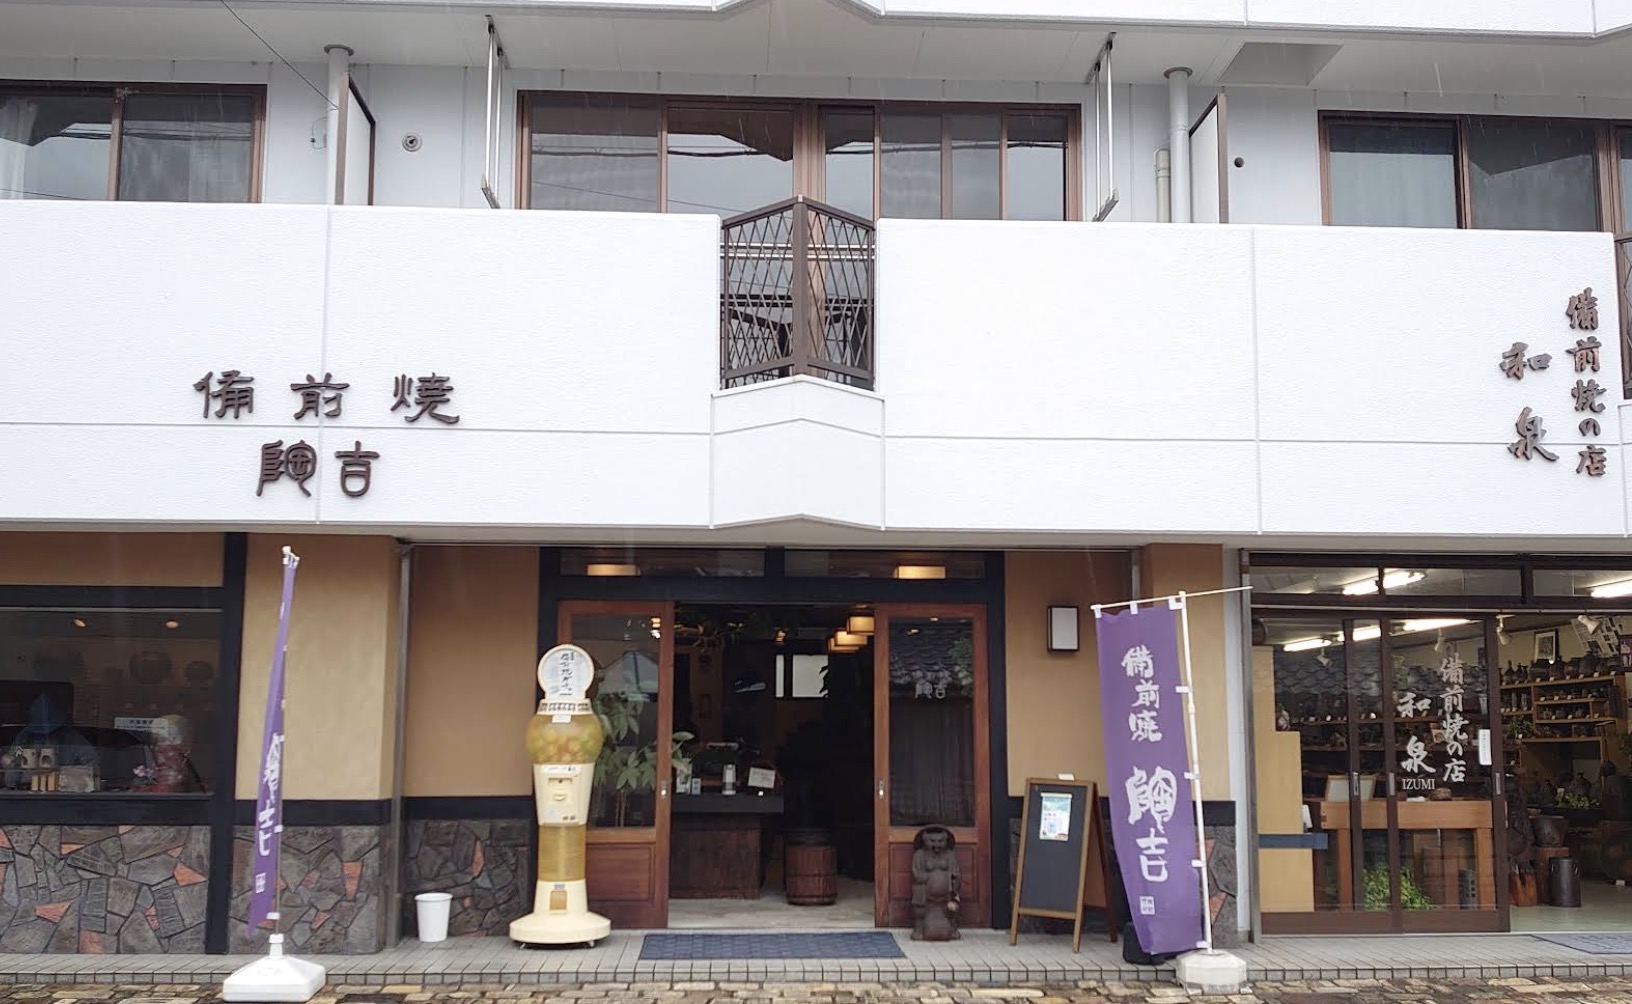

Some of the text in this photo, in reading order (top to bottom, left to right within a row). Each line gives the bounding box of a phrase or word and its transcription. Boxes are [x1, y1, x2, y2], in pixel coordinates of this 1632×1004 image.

[1499, 341, 1560, 462] 和泉
[1565, 287, 1607, 477] 備前焼の店
[1396, 692, 1436, 773] 和泉
[1440, 652, 1469, 783] 備前焼の店
[1402, 778, 1436, 790] IZUMI
